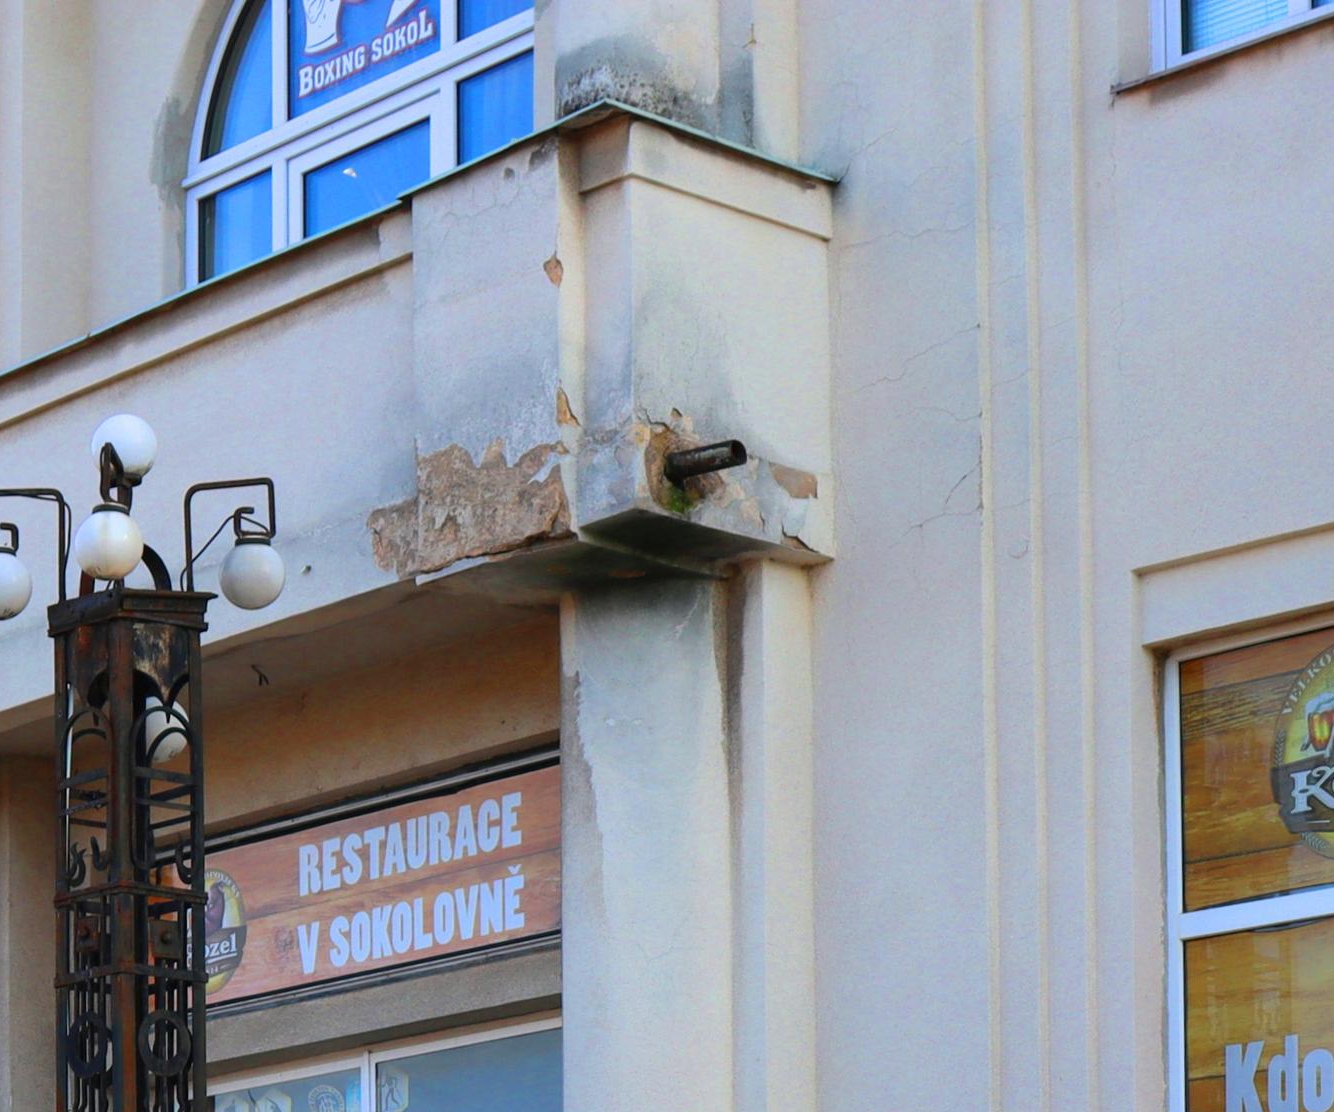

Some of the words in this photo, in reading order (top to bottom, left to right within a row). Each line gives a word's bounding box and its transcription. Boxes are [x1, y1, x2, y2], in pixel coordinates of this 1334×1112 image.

[297, 791, 523, 897] RESTAURACE
[296, 920, 320, 975] V
[329, 864, 525, 968] SOKOLOVNĚ
